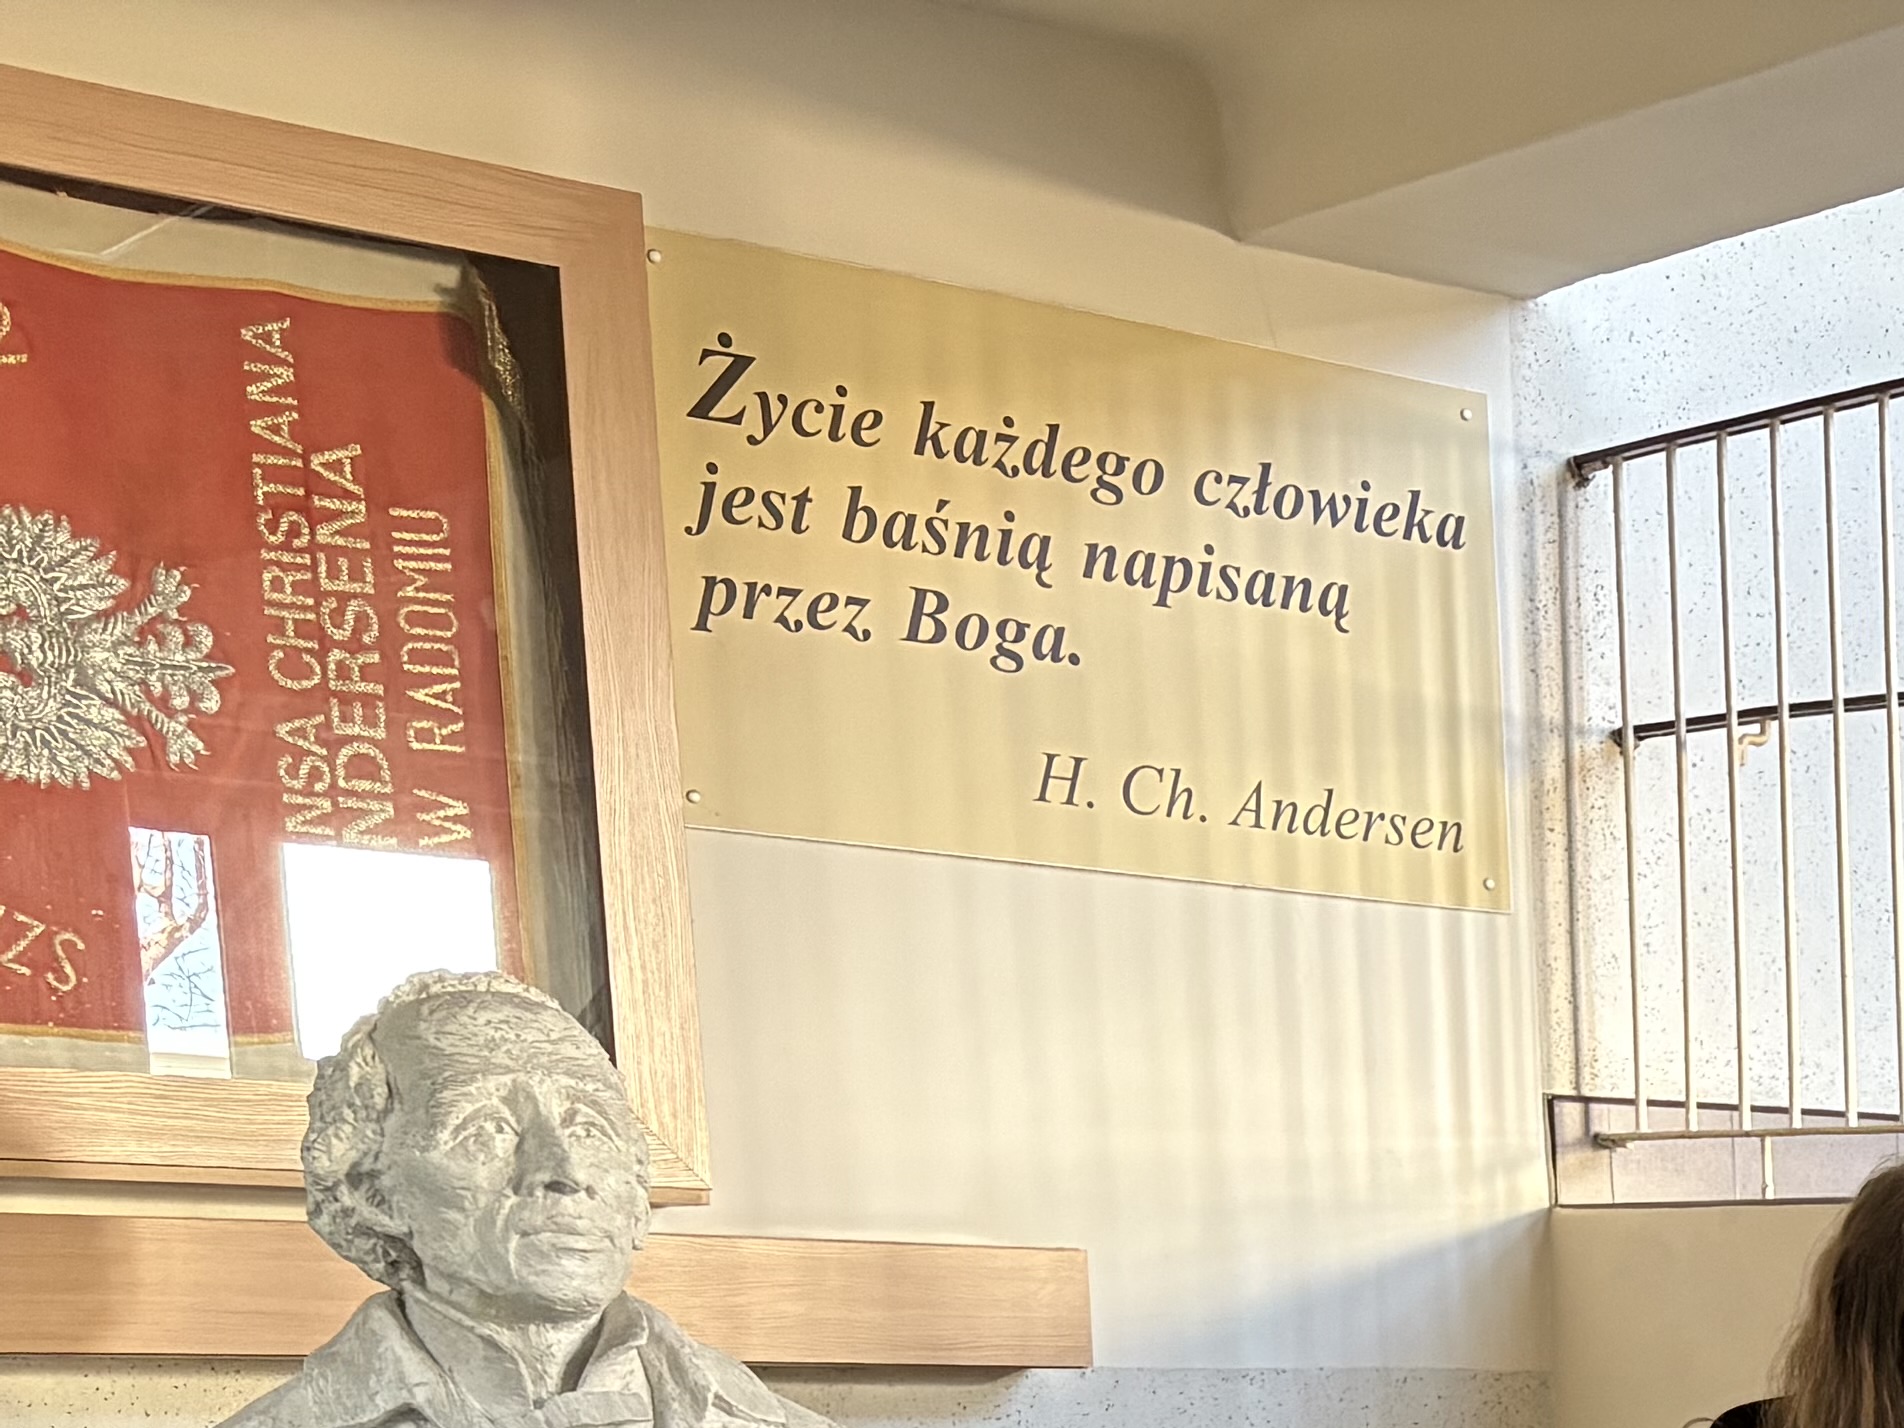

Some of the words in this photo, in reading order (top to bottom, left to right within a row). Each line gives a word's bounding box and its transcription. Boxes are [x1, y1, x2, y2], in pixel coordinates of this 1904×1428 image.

[240, 317, 322, 690] CHRISTIANA
[686, 331, 884, 449] Życie
[913, 399, 1166, 505] każdego
[1193, 461, 1466, 551] człowieka
[388, 506, 465, 752] RADOMIU
[684, 462, 813, 537] jest
[842, 486, 1054, 589] baśnią
[1083, 540, 1352, 632] napisaną
[691, 571, 872, 644] przez
[901, 587, 1082, 674] Boga.
[1034, 752, 1095, 810] H.
[1121, 765, 1207, 824] Ch.
[1228, 781, 1464, 855] Andersen
